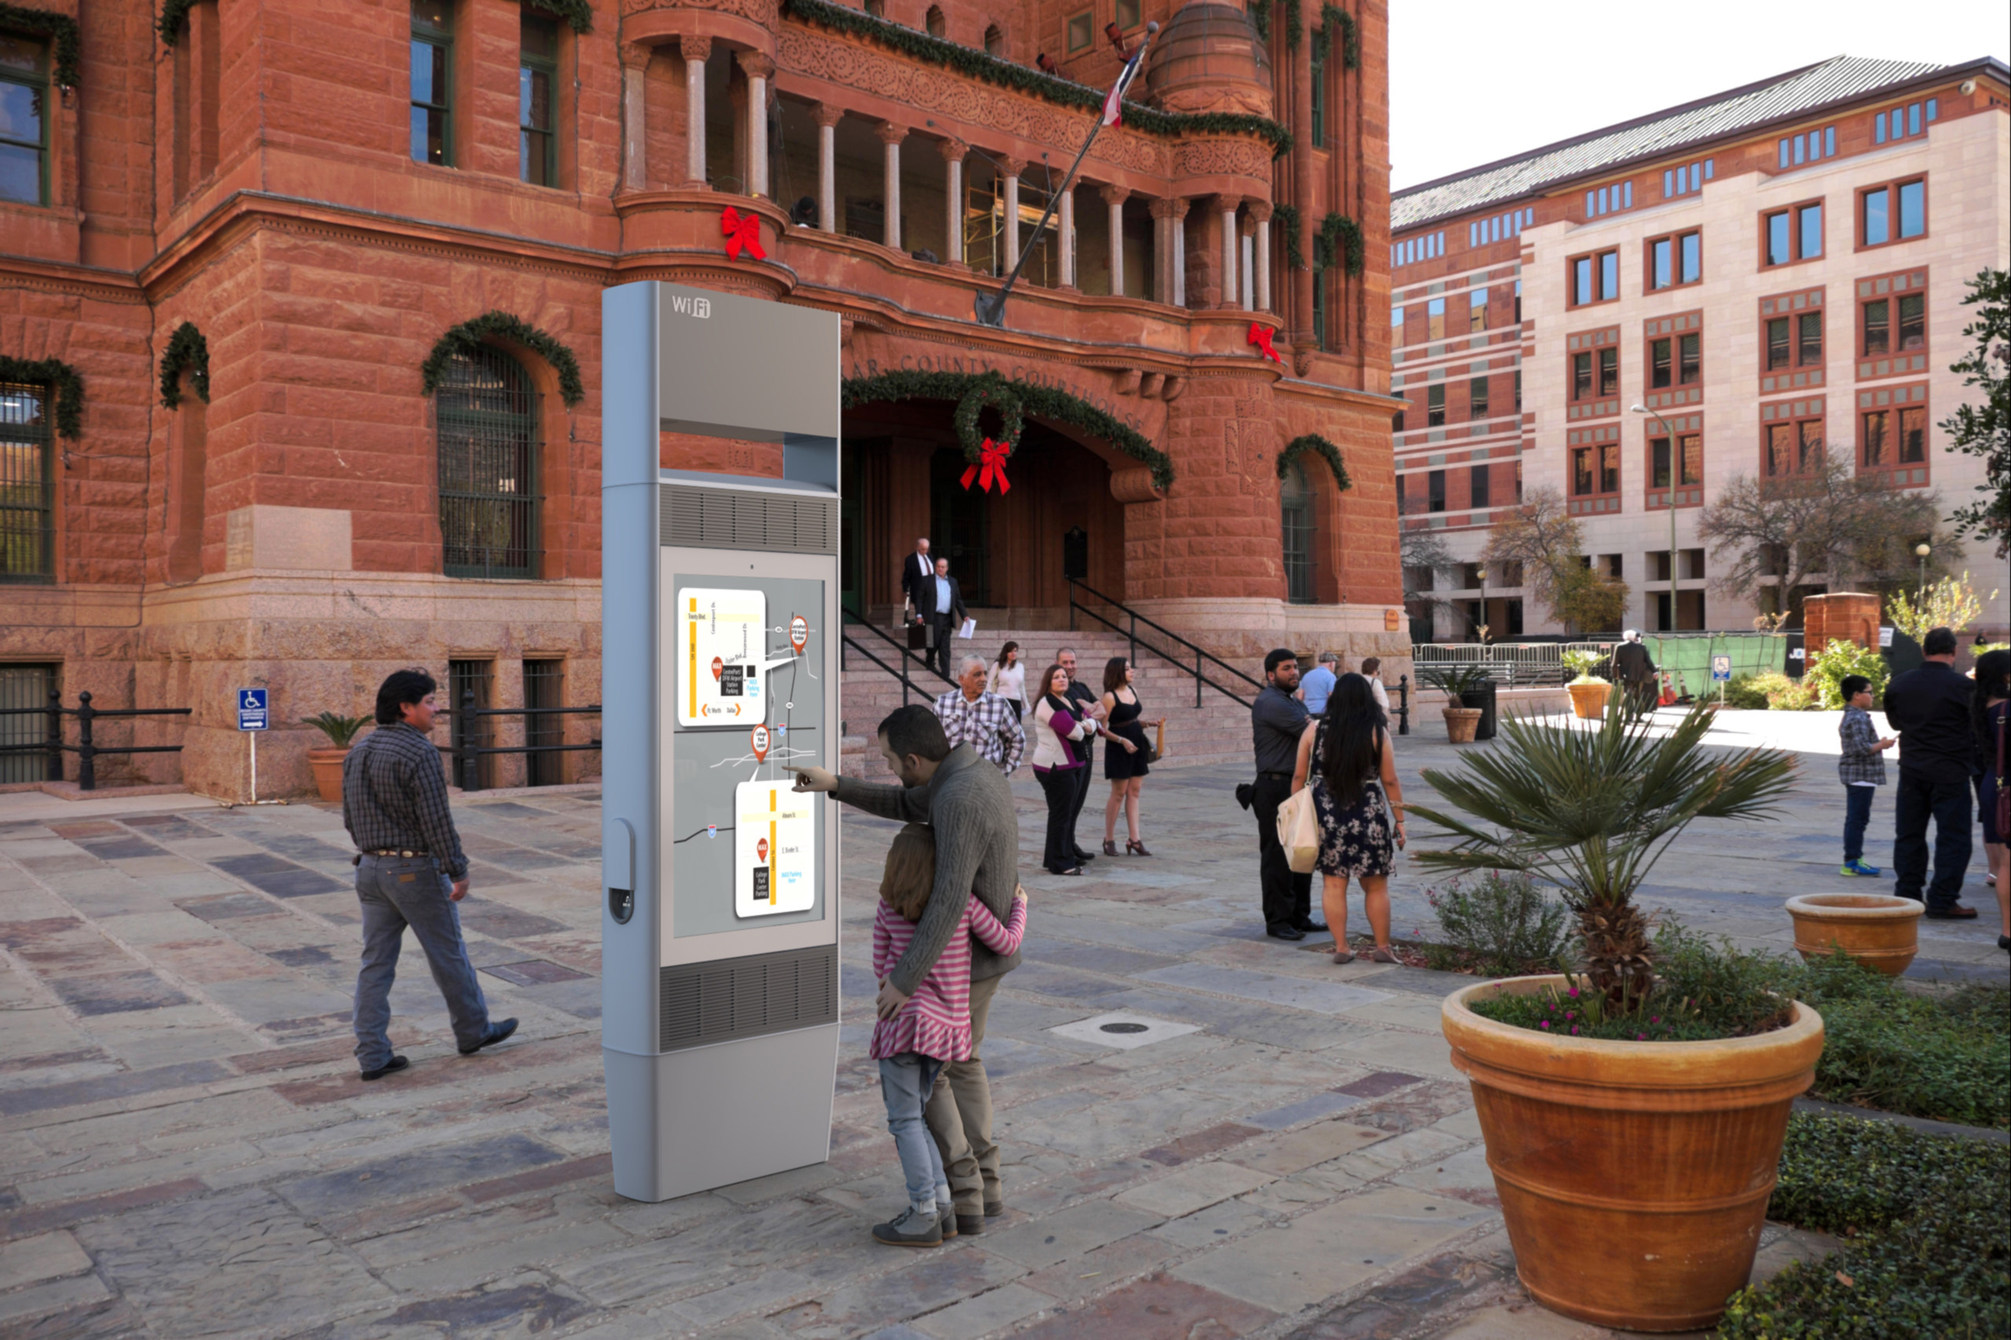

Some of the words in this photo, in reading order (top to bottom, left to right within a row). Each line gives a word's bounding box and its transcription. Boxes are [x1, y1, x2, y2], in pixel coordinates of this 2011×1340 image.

[900, 354, 993, 374] COUNTY
[1011, 365, 1145, 433] COURTHOUSE
[725, 688, 739, 696] Parking
[755, 890, 768, 898] Parking
